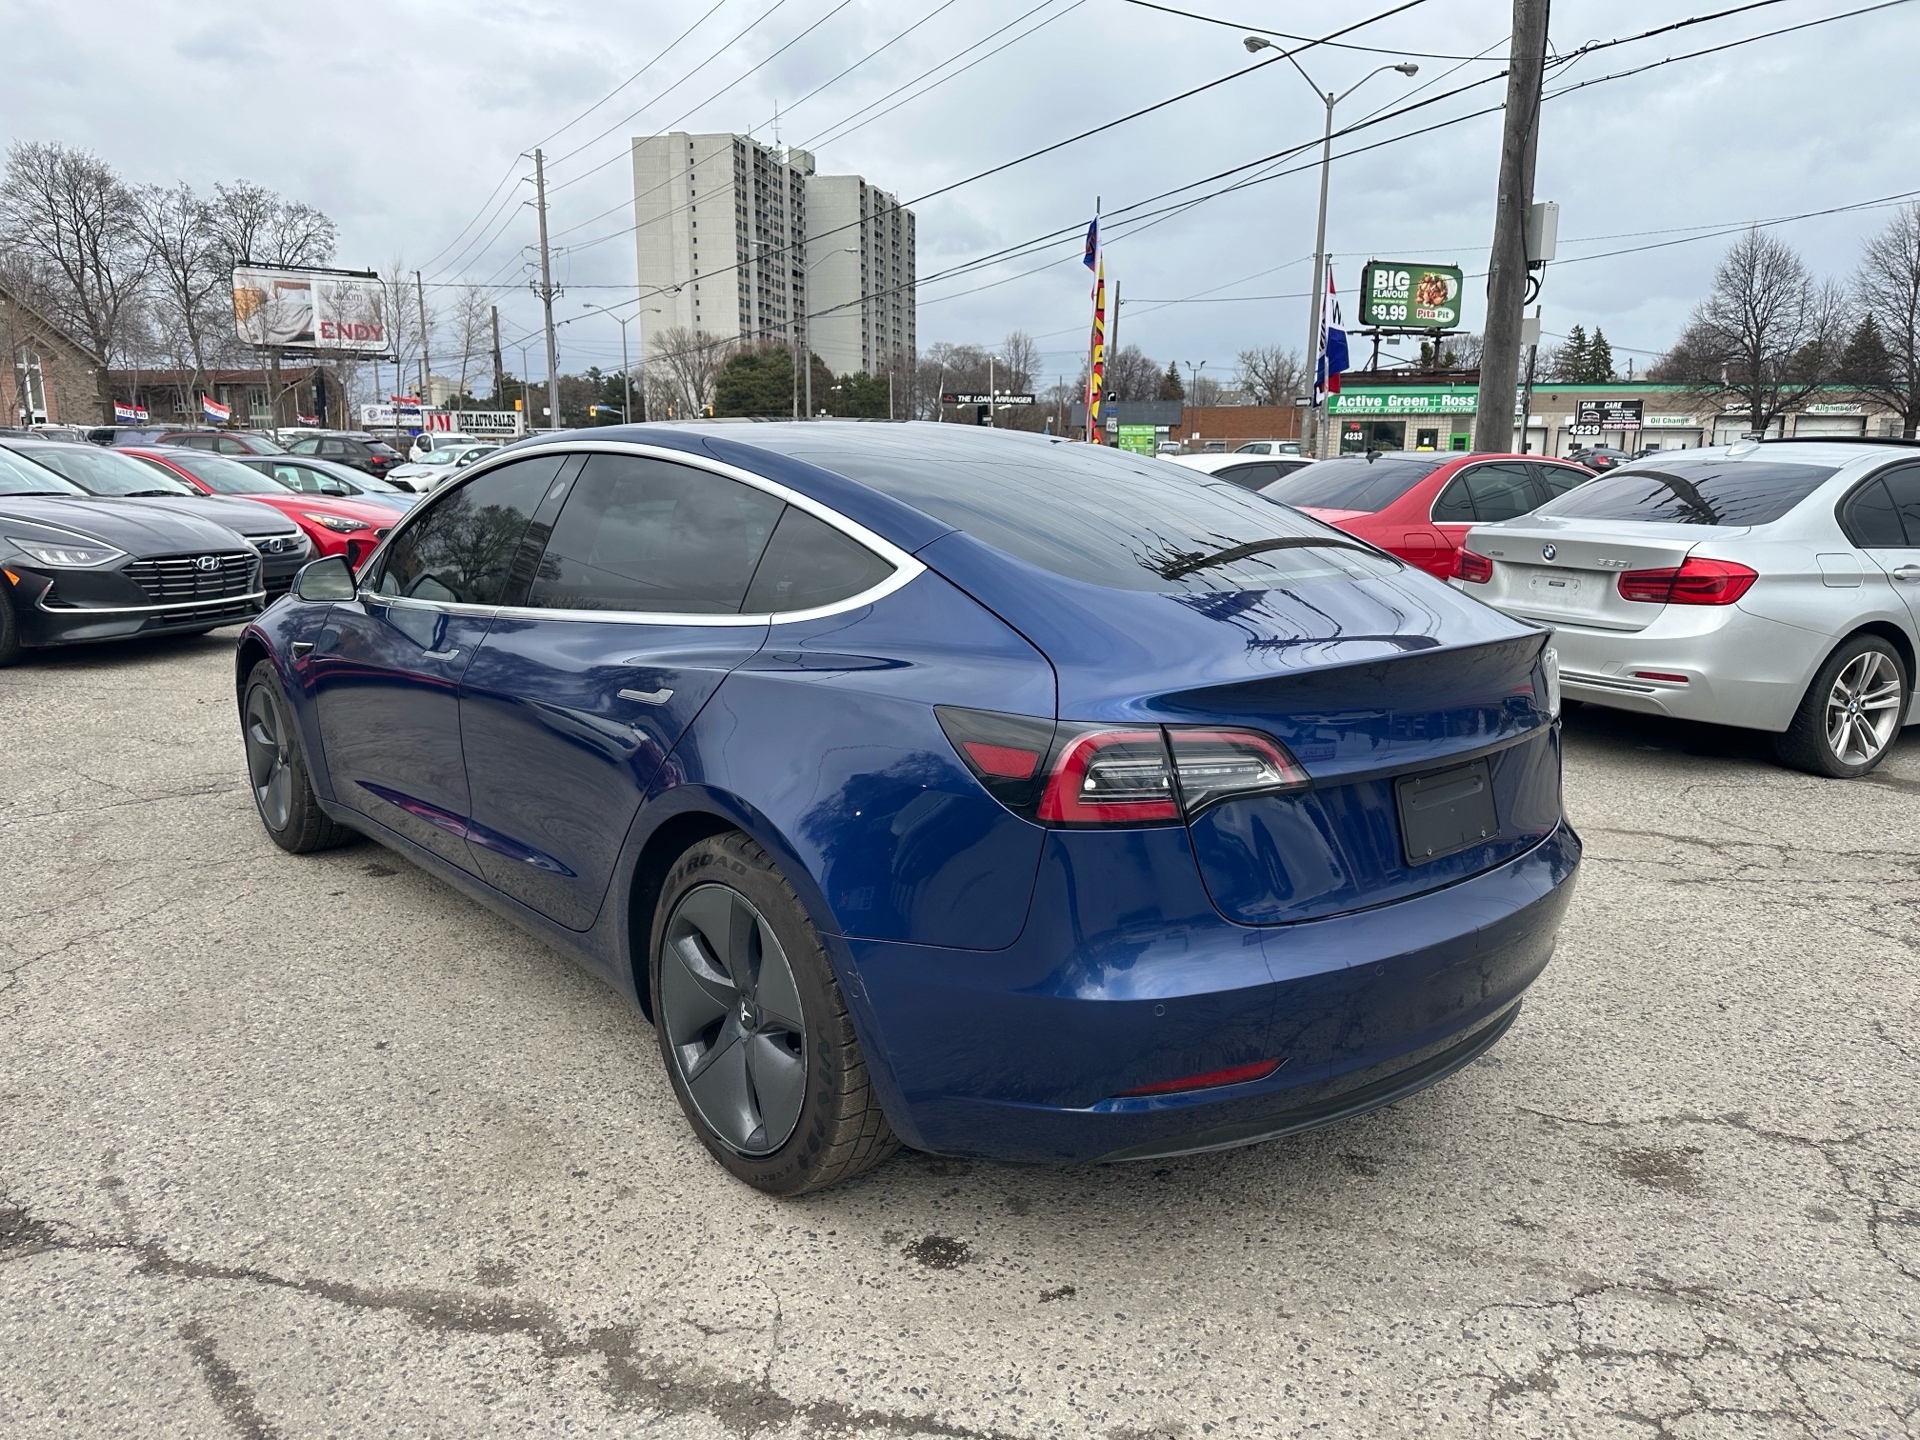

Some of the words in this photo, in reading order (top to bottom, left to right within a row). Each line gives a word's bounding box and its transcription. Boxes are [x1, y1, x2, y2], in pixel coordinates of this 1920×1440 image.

[1373, 270, 1411, 290] BIG
[1373, 291, 1408, 299] FLAVOUR
[1371, 304, 1408, 321] $9.99
[1417, 309, 1436, 319] Pita
[1437, 309, 1450, 319] Pit
[320, 321, 384, 341] ENDY
[957, 395, 972, 403] THE
[994, 395, 1032, 404] ARRANGER
[1336, 395, 1383, 407] Active
[425, 414, 452, 432] JM
[475, 413, 493, 428] AUTO
[493, 413, 516, 428] SALES
[1107, 422, 1116, 430] 60
[1650, 416, 1661, 424] Oil
[1662, 416, 1690, 426] Change
[1569, 424, 1600, 435] 4229
[1344, 432, 1363, 441] 4233
